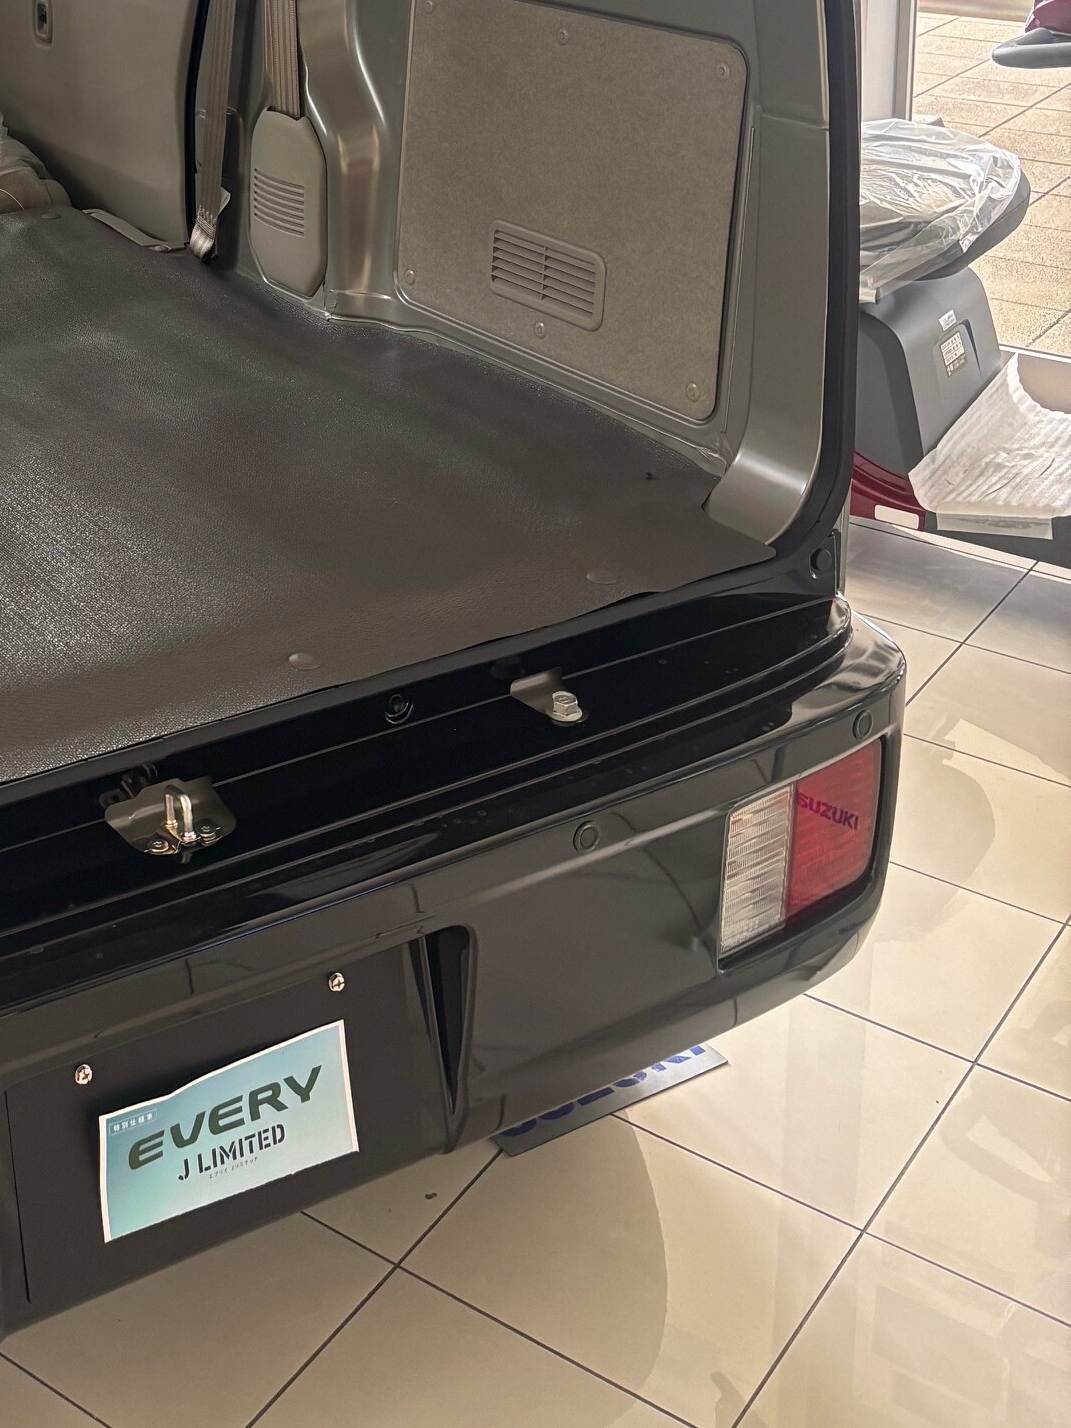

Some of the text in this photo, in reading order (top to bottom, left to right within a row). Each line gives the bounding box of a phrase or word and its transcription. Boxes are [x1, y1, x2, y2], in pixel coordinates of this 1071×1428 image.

[799, 792, 859, 830] SUZUKI
[129, 1065, 322, 1170] EVERY
[178, 1123, 285, 1181] J LIMITED
